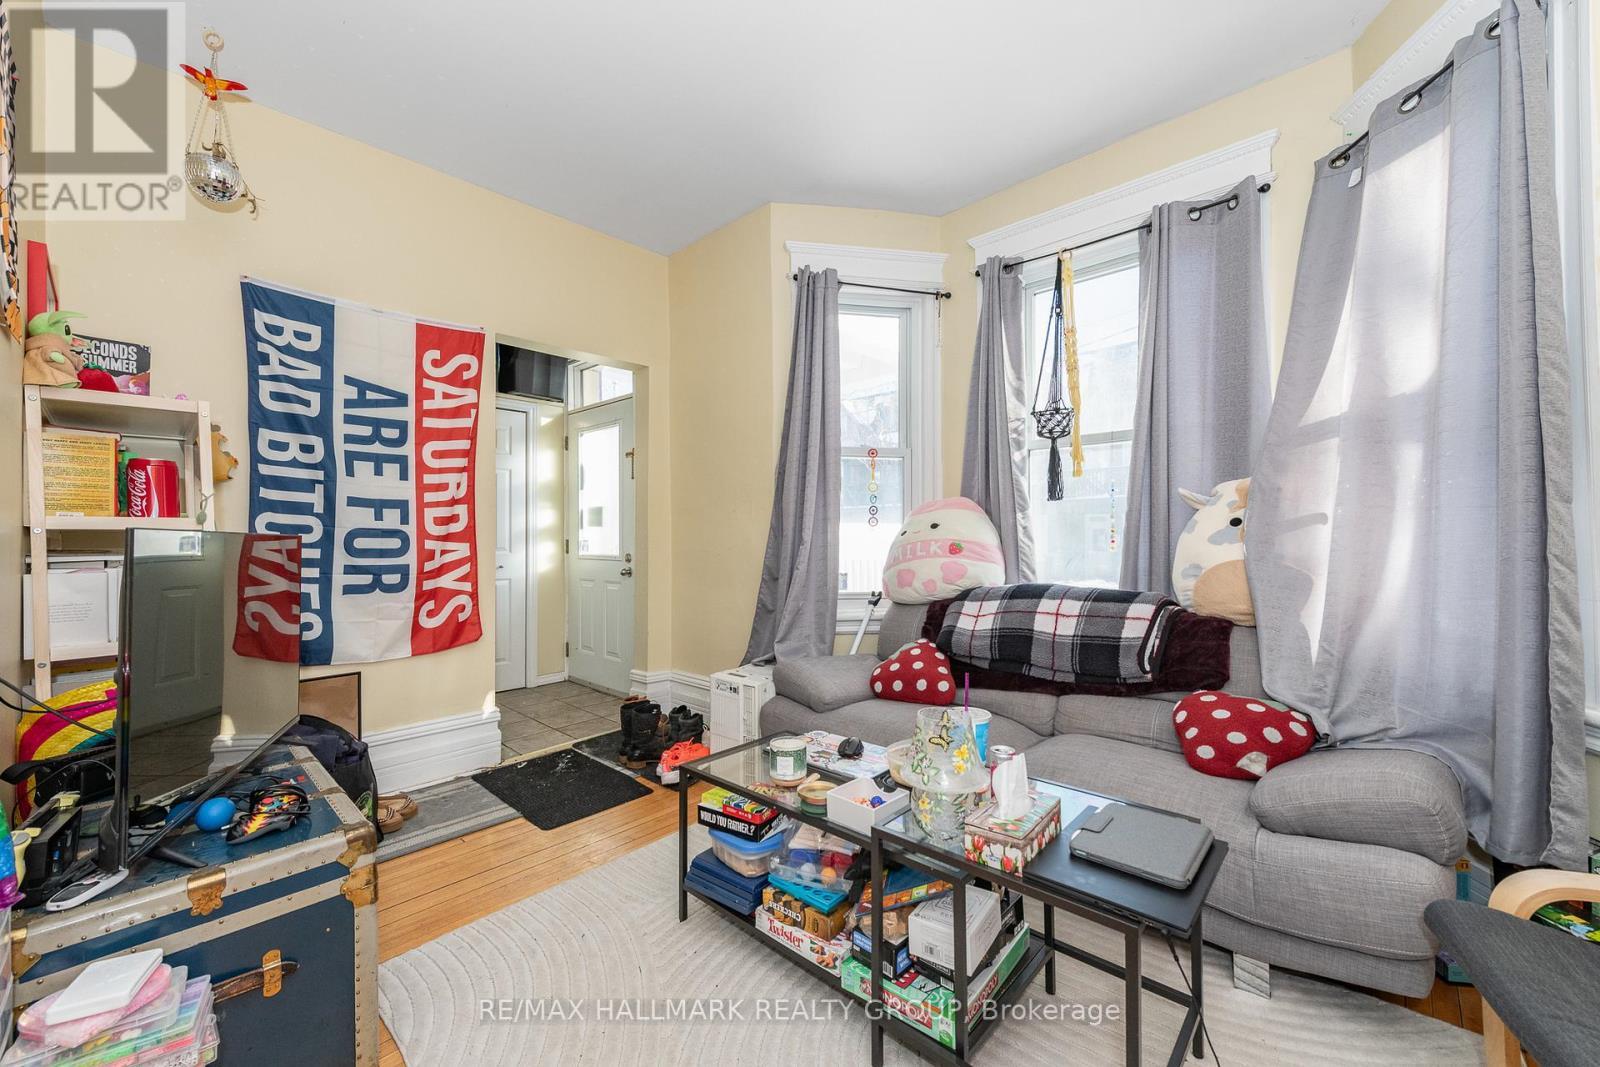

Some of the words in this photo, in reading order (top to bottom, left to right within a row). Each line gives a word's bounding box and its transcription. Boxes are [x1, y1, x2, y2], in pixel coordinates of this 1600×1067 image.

[253, 307, 322, 419] BAD
[343, 374, 409, 482] ARE
[418, 349, 479, 630] SATURDAYS
[341, 495, 411, 596] FOR
[700, 810, 717, 824] WOULD
[716, 814, 727, 828] YOU
[768, 916, 803, 949] Twister
